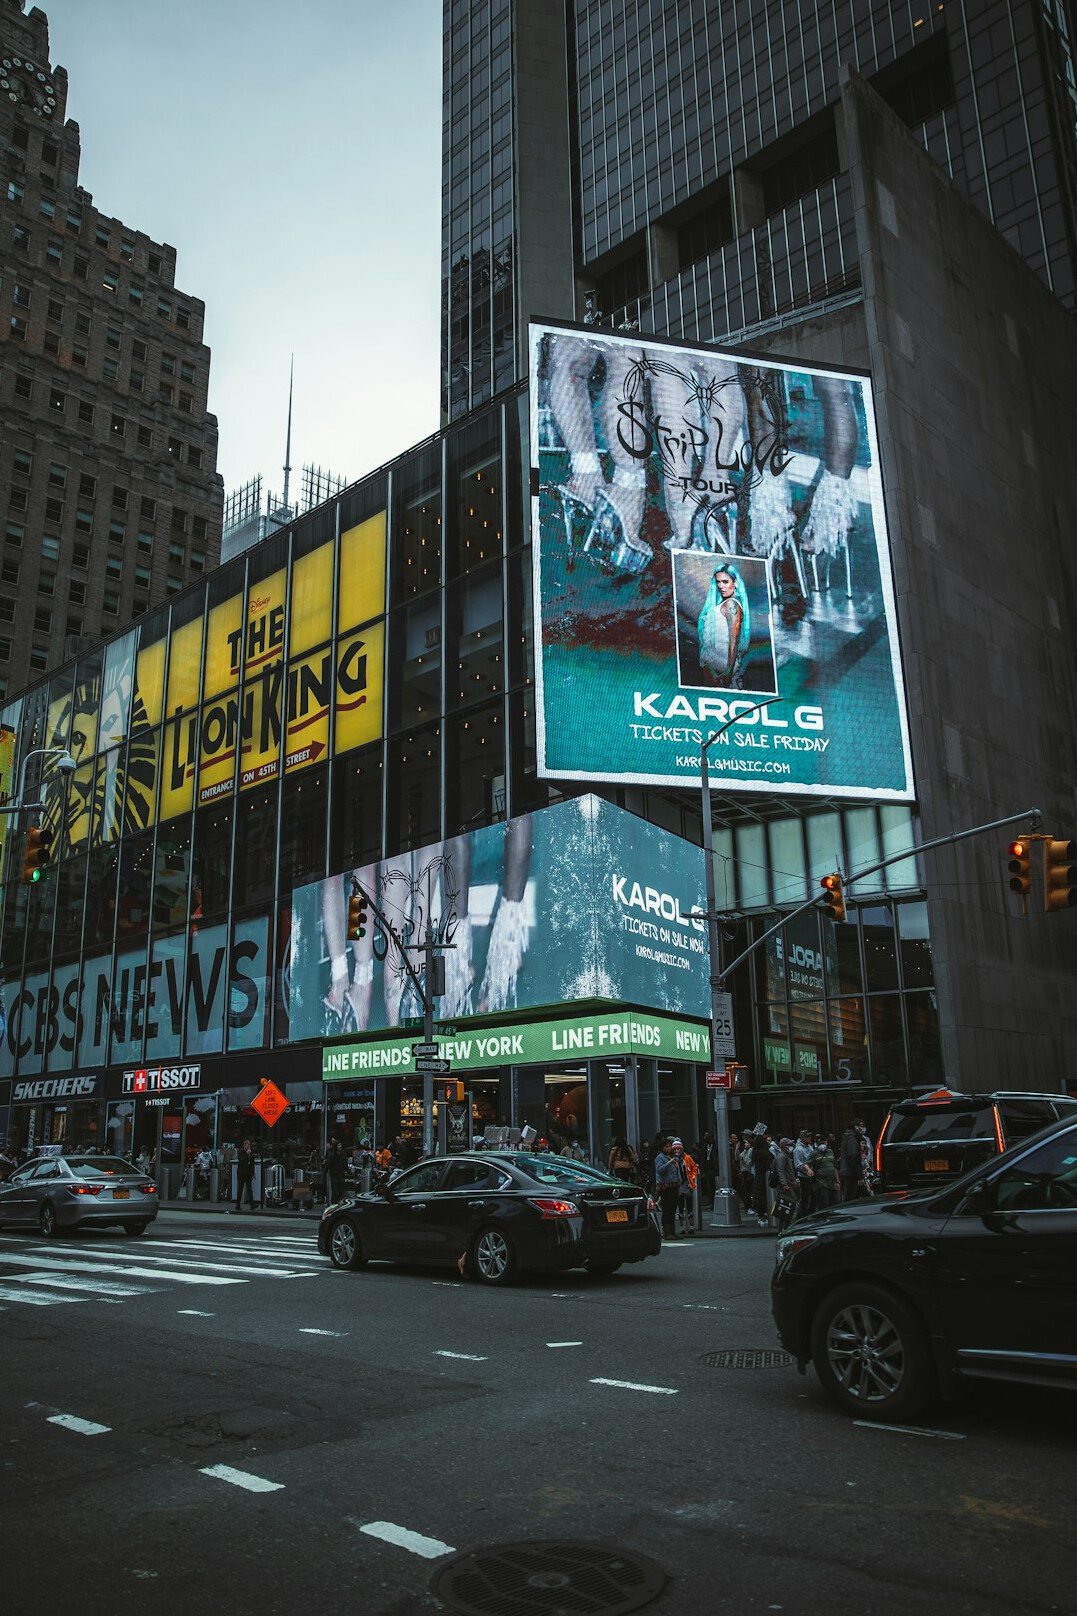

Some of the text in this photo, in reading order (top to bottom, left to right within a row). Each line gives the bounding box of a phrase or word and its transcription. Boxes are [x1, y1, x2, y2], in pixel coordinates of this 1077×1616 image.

[679, 477, 740, 495] TOUR
[227, 604, 285, 669] THE
[171, 640, 368, 792] LION KING
[633, 691, 825, 731] KAROL G
[629, 724, 830, 752] TICKETS ON SALE FRIDAY
[201, 748, 311, 800] ENTRANCE ON 45TH STREET
[612, 873, 690, 927] KAROL
[622, 914, 705, 955] TICKETS ON SALE NOW
[8, 940, 260, 1059] CBS NEWS
[551, 1022, 661, 1051] LINE FRIENDS
[676, 1030, 700, 1052] NEW
[716, 1018, 731, 1036] 25
[352, 1046, 411, 1070] FRIENDS
[475, 1034, 525, 1058] YORK
[13, 1075, 97, 1101] SKECHERS
